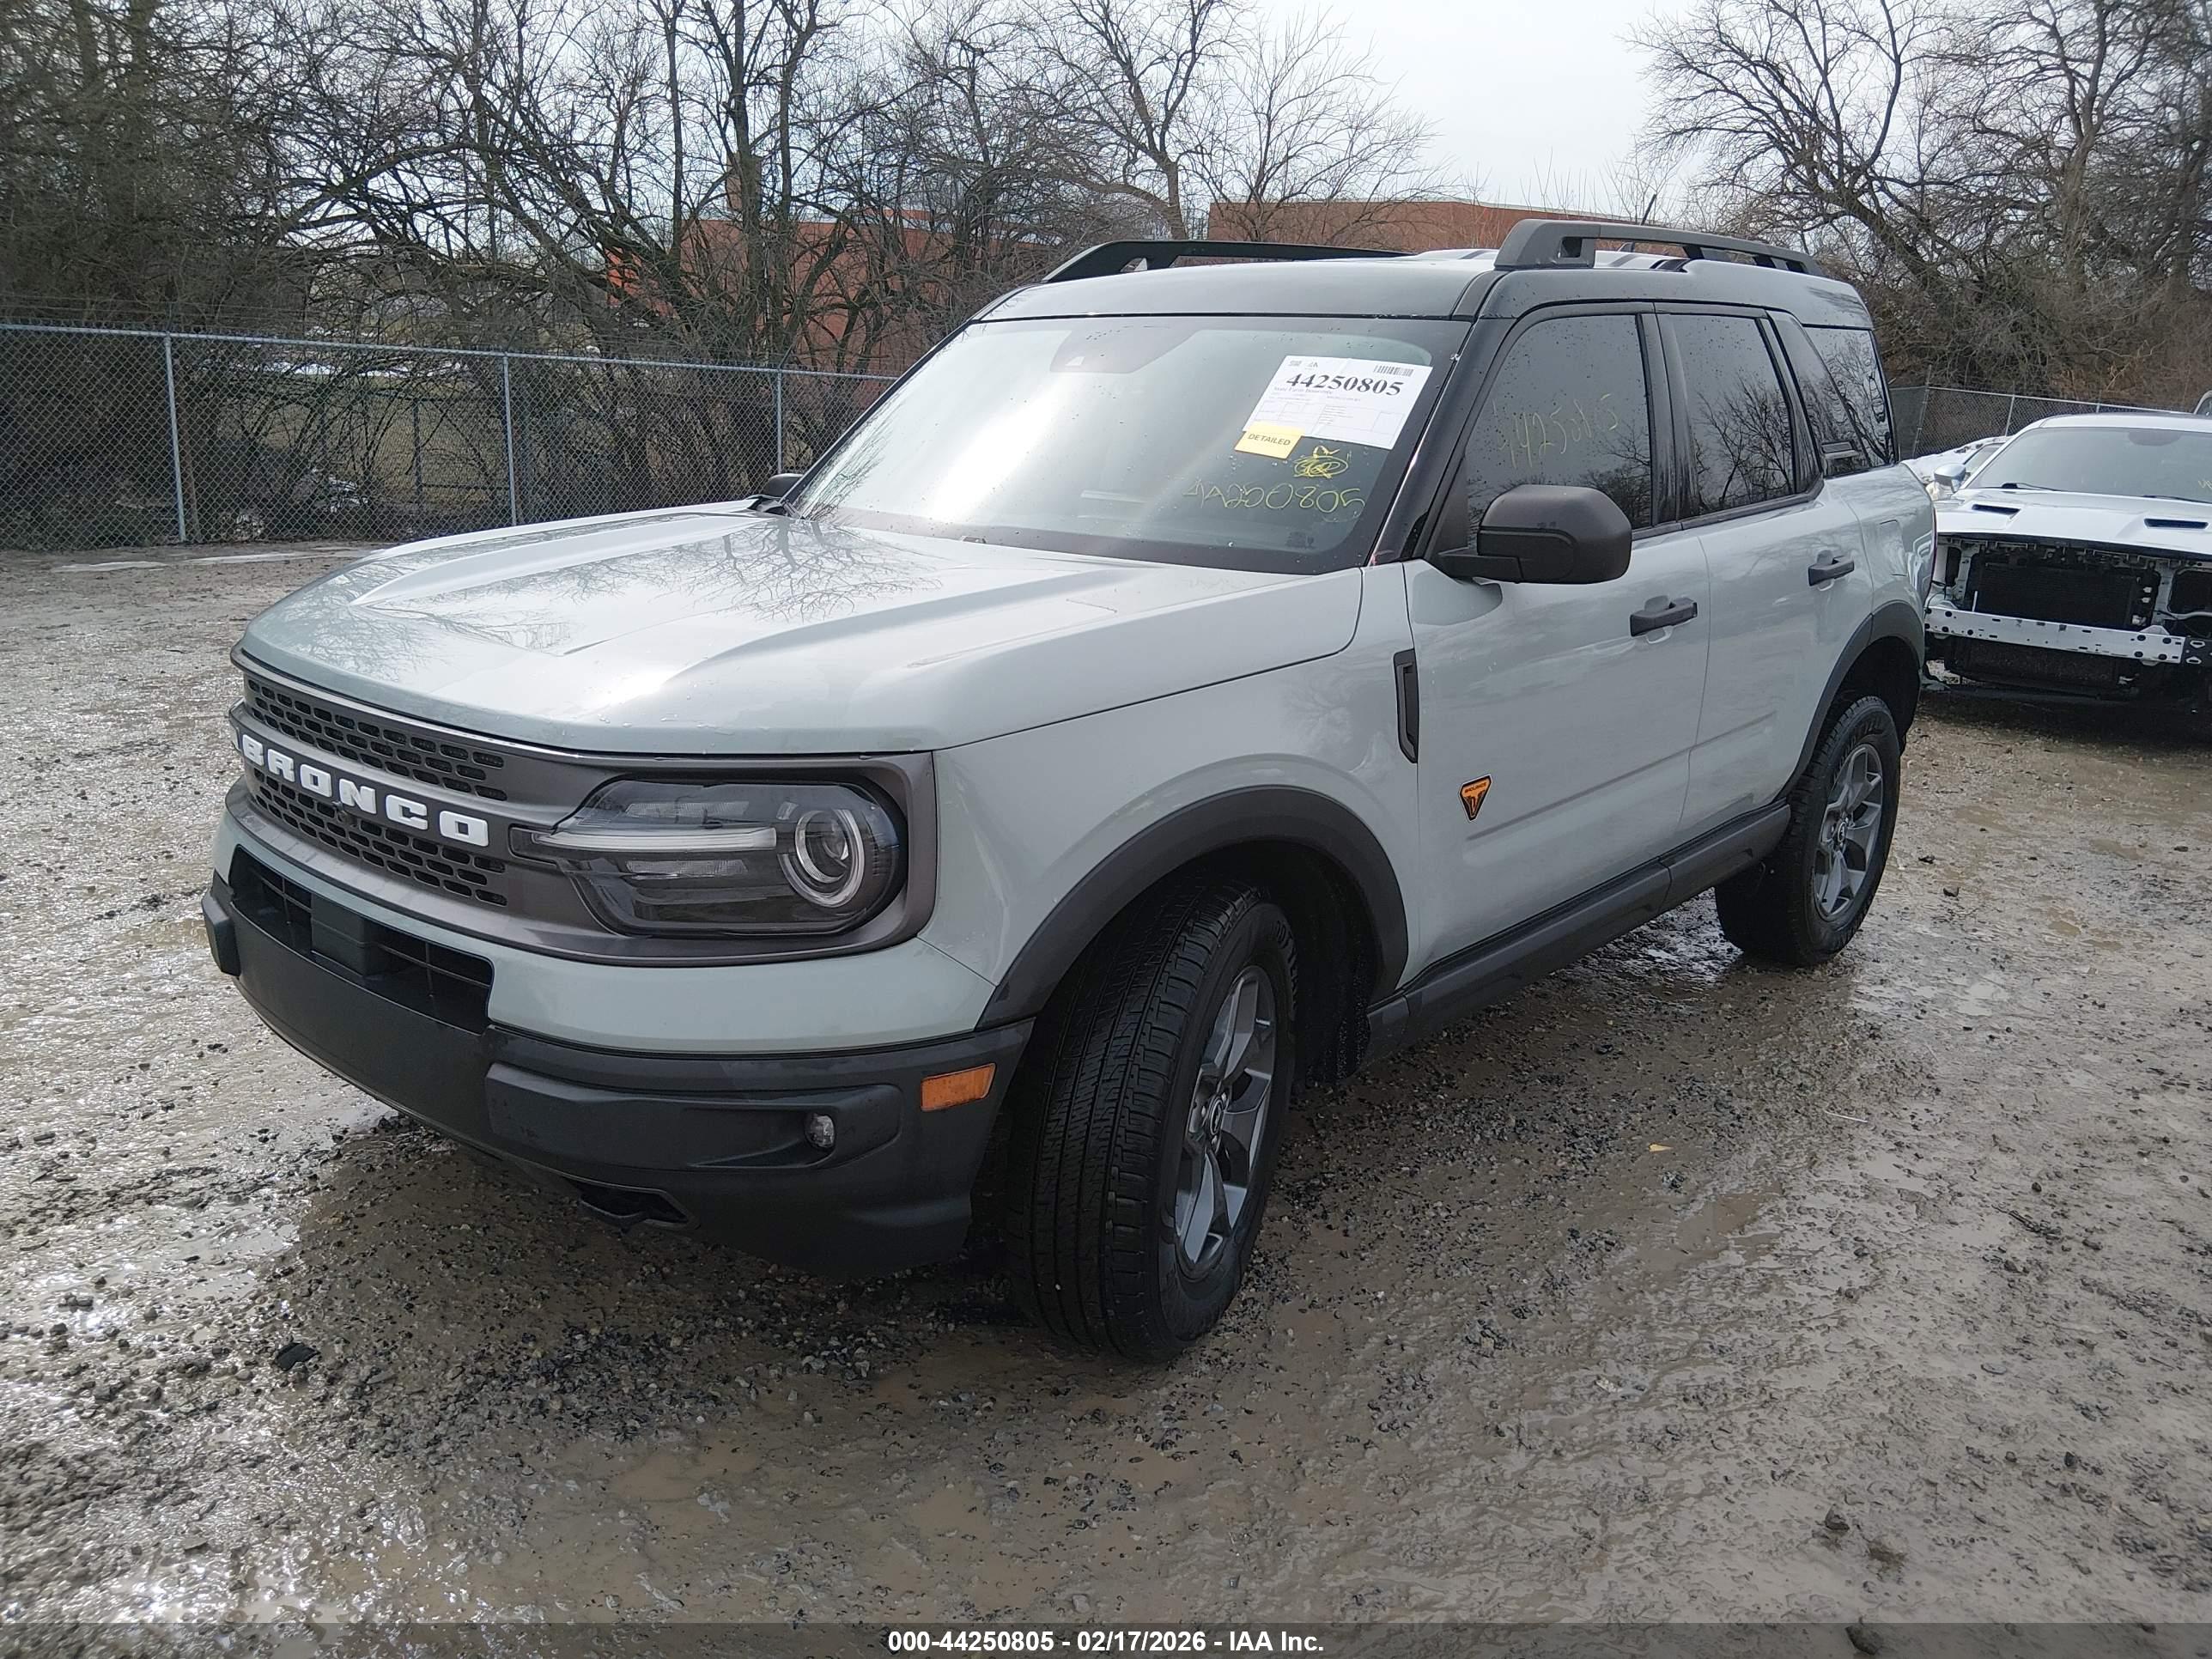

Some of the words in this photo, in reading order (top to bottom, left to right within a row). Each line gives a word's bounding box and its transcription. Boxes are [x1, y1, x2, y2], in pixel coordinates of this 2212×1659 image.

[1285, 373, 1404, 396] 44250805
[1248, 433, 1291, 446] DETAILED
[242, 733, 489, 848] BRONCO
